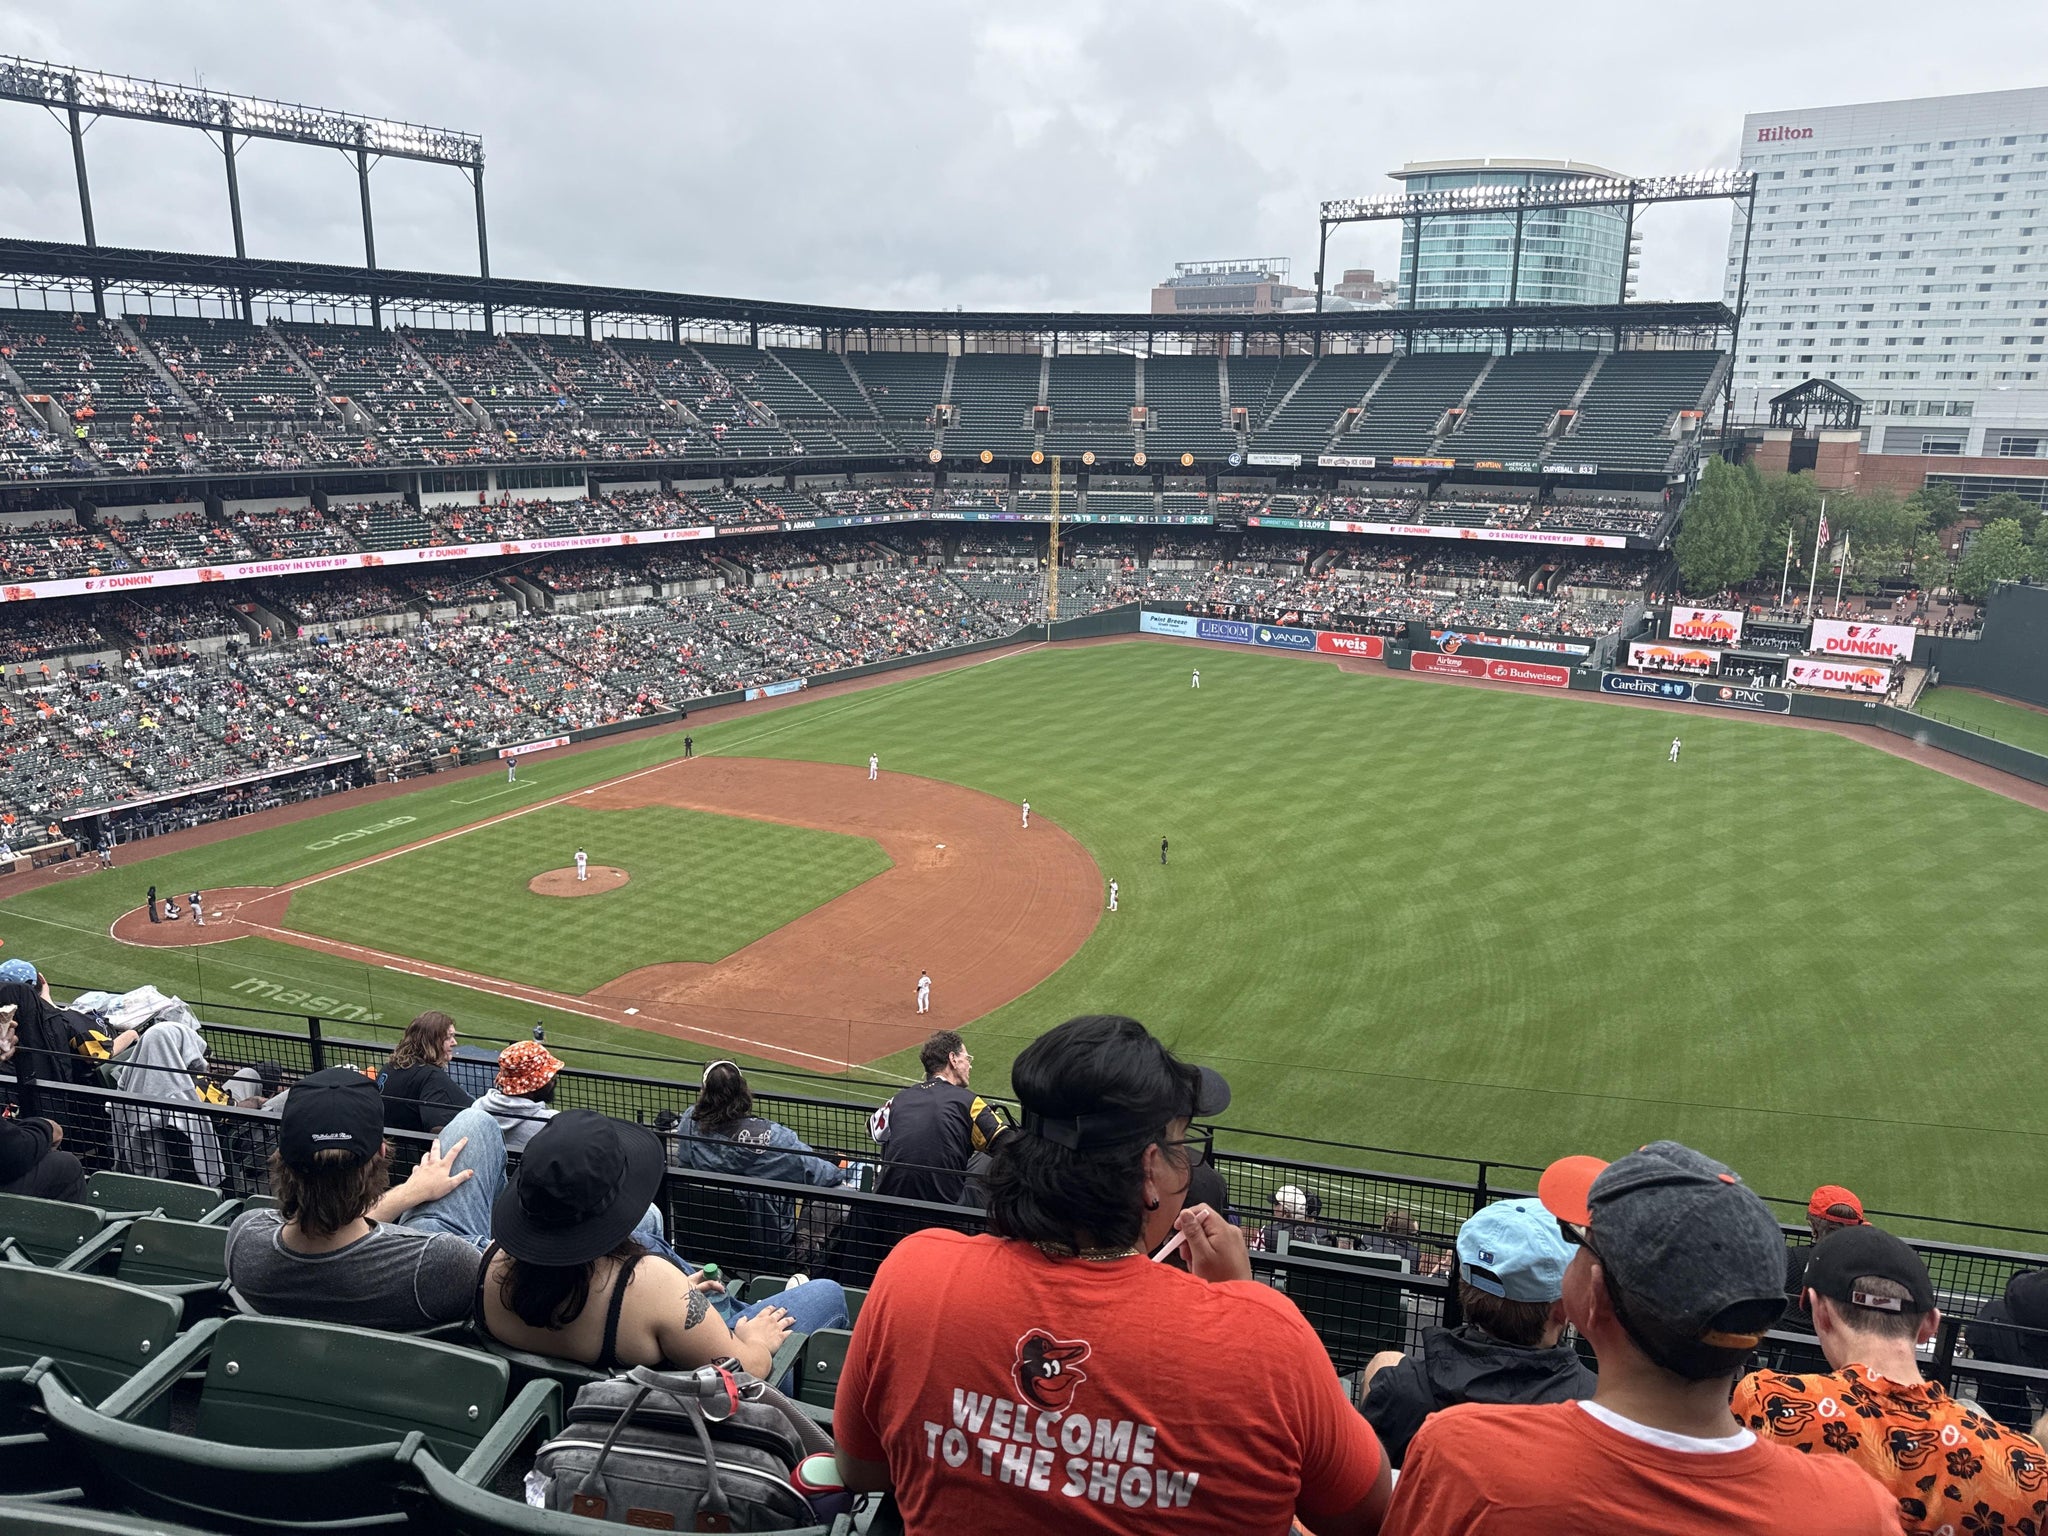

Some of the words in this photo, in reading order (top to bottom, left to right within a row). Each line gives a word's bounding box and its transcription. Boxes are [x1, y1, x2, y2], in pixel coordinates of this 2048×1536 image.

[1757, 126, 1813, 142] Hilton
[1476, 461, 1501, 469] POMPEIAN
[1543, 465, 1573, 473] CURVEBALL
[1579, 466, 1593, 474] 83.2
[793, 521, 816, 529] ARANDA
[1299, 521, 1325, 529] $13,092
[676, 530, 700, 538] DUNKIN'
[544, 540, 570, 548] ENERGY
[436, 548, 468, 557] DUNKIN'
[239, 566, 254, 574] O'S
[256, 563, 291, 573] ENERGY
[305, 560, 332, 569] EVERY
[334, 558, 347, 566] SIP
[109, 575, 154, 587] DUNKIN'
[1201, 623, 1249, 636] LECOM
[1673, 624, 1737, 640] DUNKIN'
[1272, 632, 1310, 644] VANDA
[1331, 637, 1368, 650] weis
[1501, 637, 1526, 648] BIRD
[1529, 639, 1557, 651] BATH
[1826, 638, 1897, 656] DUNKIN'
[1438, 656, 1462, 667] Airtemp
[1510, 667, 1562, 682] Budweiser
[1823, 670, 1884, 686] DUNKIN'
[1611, 678, 1659, 693] CareFirst
[1735, 689, 1764, 702] PNC
[305, 816, 417, 850] GEICO
[952, 1388, 1157, 1465] WELCOME
[924, 1421, 969, 1468] TO
[977, 1438, 1055, 1492] THE
[1061, 1457, 1199, 1509] SHOW
